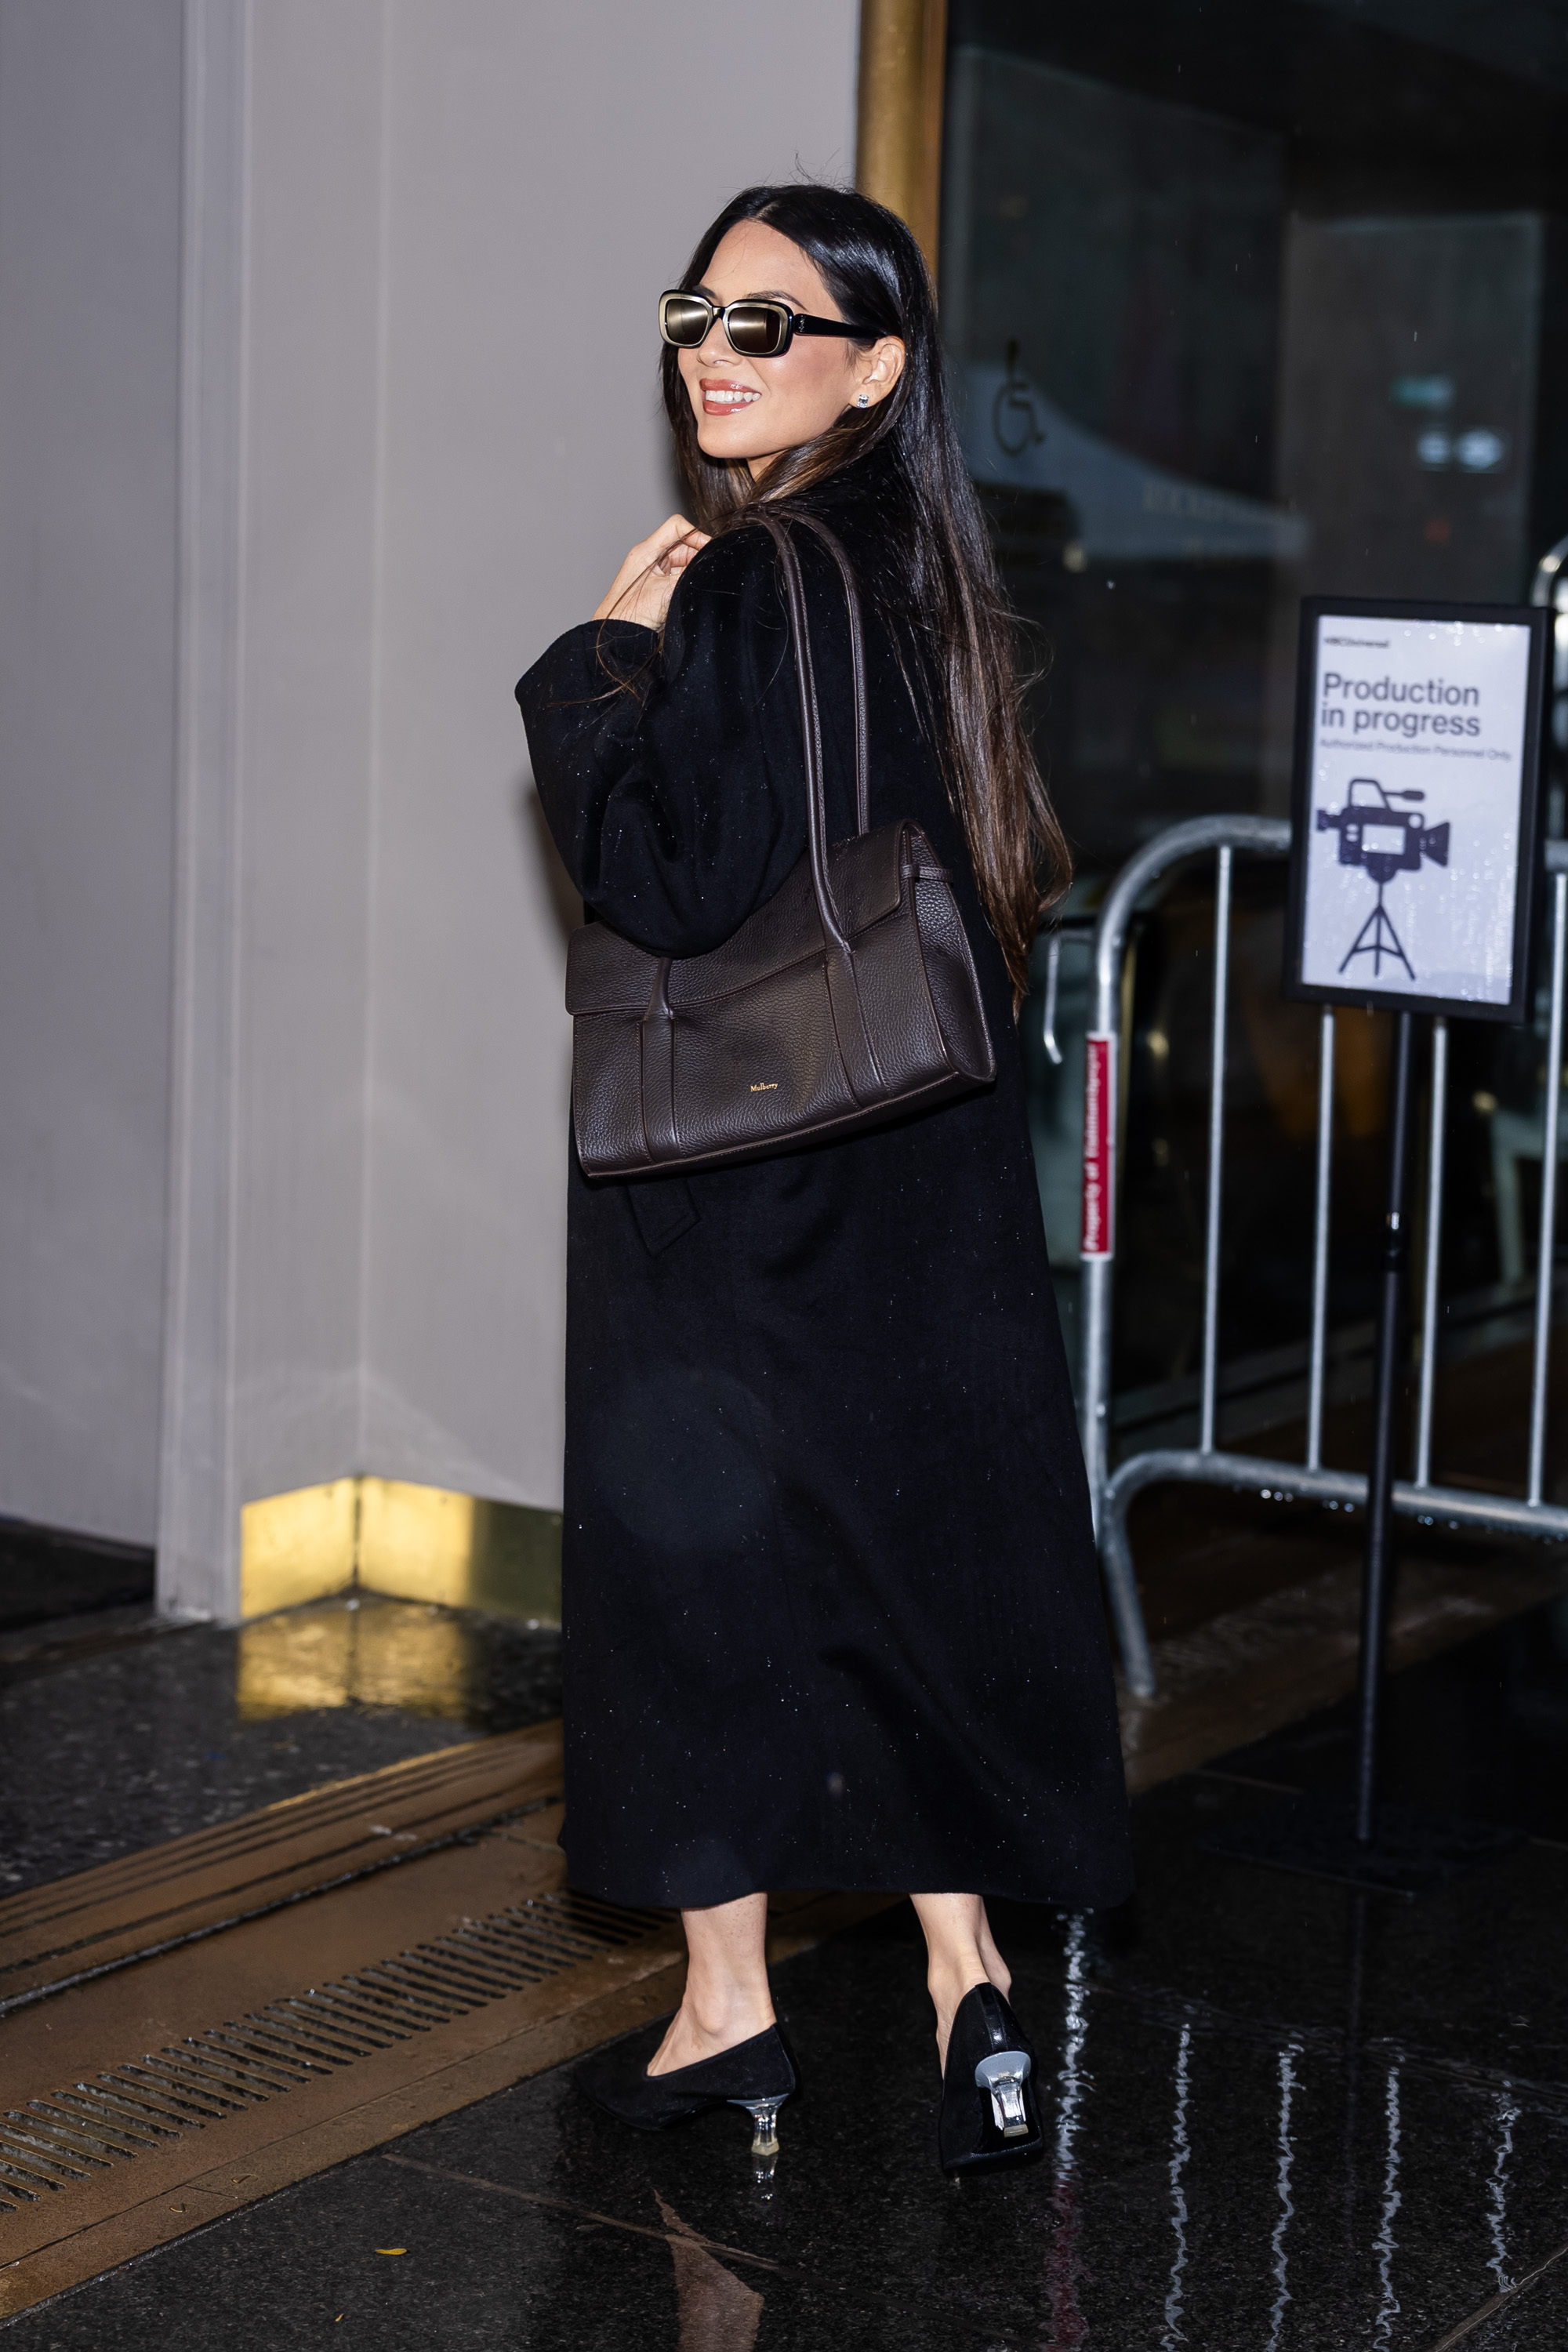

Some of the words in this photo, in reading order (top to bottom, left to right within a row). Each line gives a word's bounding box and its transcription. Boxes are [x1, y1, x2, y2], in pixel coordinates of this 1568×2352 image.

[1323, 672, 1479, 706] Production
[1321, 703, 1345, 728] in
[1352, 708, 1481, 739] progress
[1377, 742, 1431, 754] Production
[750, 1082, 778, 1092] Mulberry
